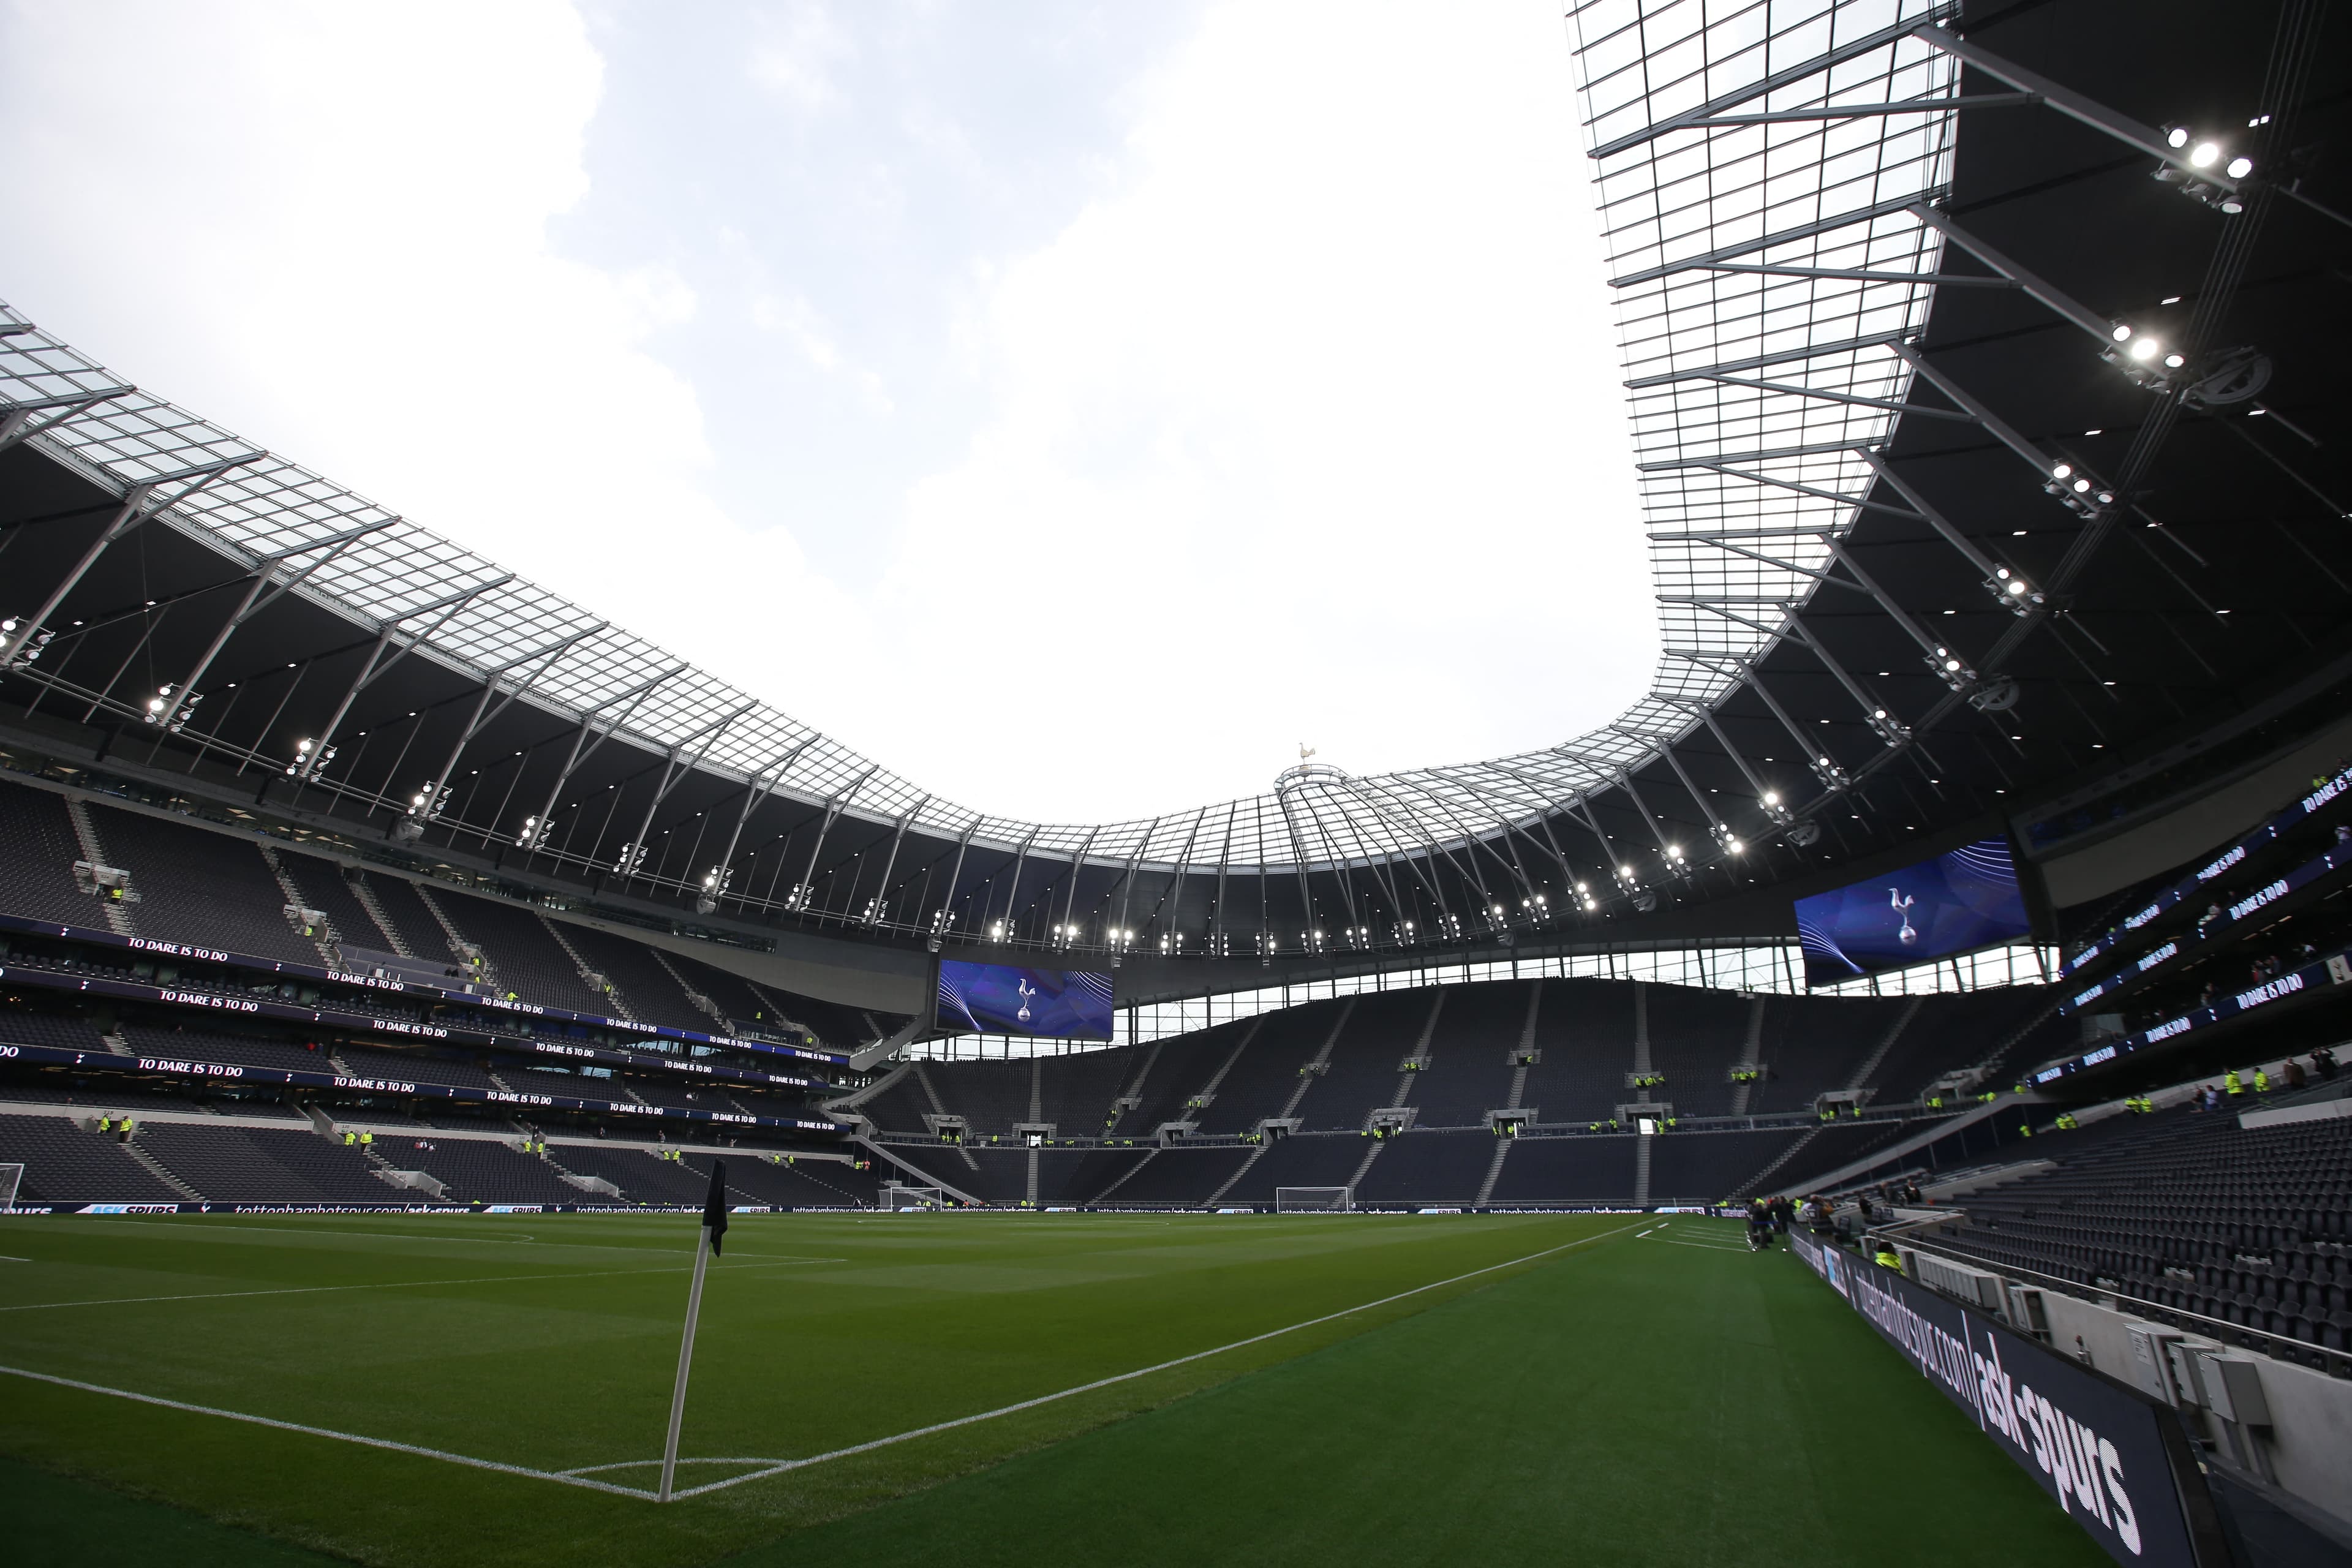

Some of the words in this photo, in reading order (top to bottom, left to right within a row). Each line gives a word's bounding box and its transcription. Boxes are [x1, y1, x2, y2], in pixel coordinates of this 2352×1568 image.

[129, 938, 145, 948] TO
[147, 941, 178, 953] DARE
[180, 946, 192, 956] IS
[195, 948, 209, 958] TO
[211, 951, 227, 961] DO
[328, 971, 339, 980] TO
[341, 974, 365, 984] DARE
[378, 979, 389, 988] TO
[391, 982, 404, 990] DO
[161, 990, 176, 1000] TO
[178, 993, 209, 1005] DARE
[211, 998, 222, 1007] IS
[226, 1000, 239, 1009] TO
[241, 1002, 258, 1011] DO
[492, 999, 512, 1009] DARE
[374, 1020, 385, 1029] TO
[386, 1022, 410, 1032] DARE
[423, 1027, 433, 1035] TO
[434, 1028, 447, 1037] DO
[615, 1020, 631, 1028] DARE
[546, 1044, 565, 1054] DARE
[140, 1058, 155, 1069] TO
[158, 1061, 191, 1072] DARE
[194, 1064, 205, 1073] IS
[209, 1065, 223, 1074] TO
[225, 1067, 243, 1076] DO
[334, 1077, 347, 1086] TO
[349, 1079, 374, 1088] DARE
[376, 1081, 385, 1090] IS
[388, 1082, 399, 1091] TO
[401, 1084, 415, 1092] DO
[499, 1093, 519, 1101] DARE
[530, 1095, 539, 1104] TO
